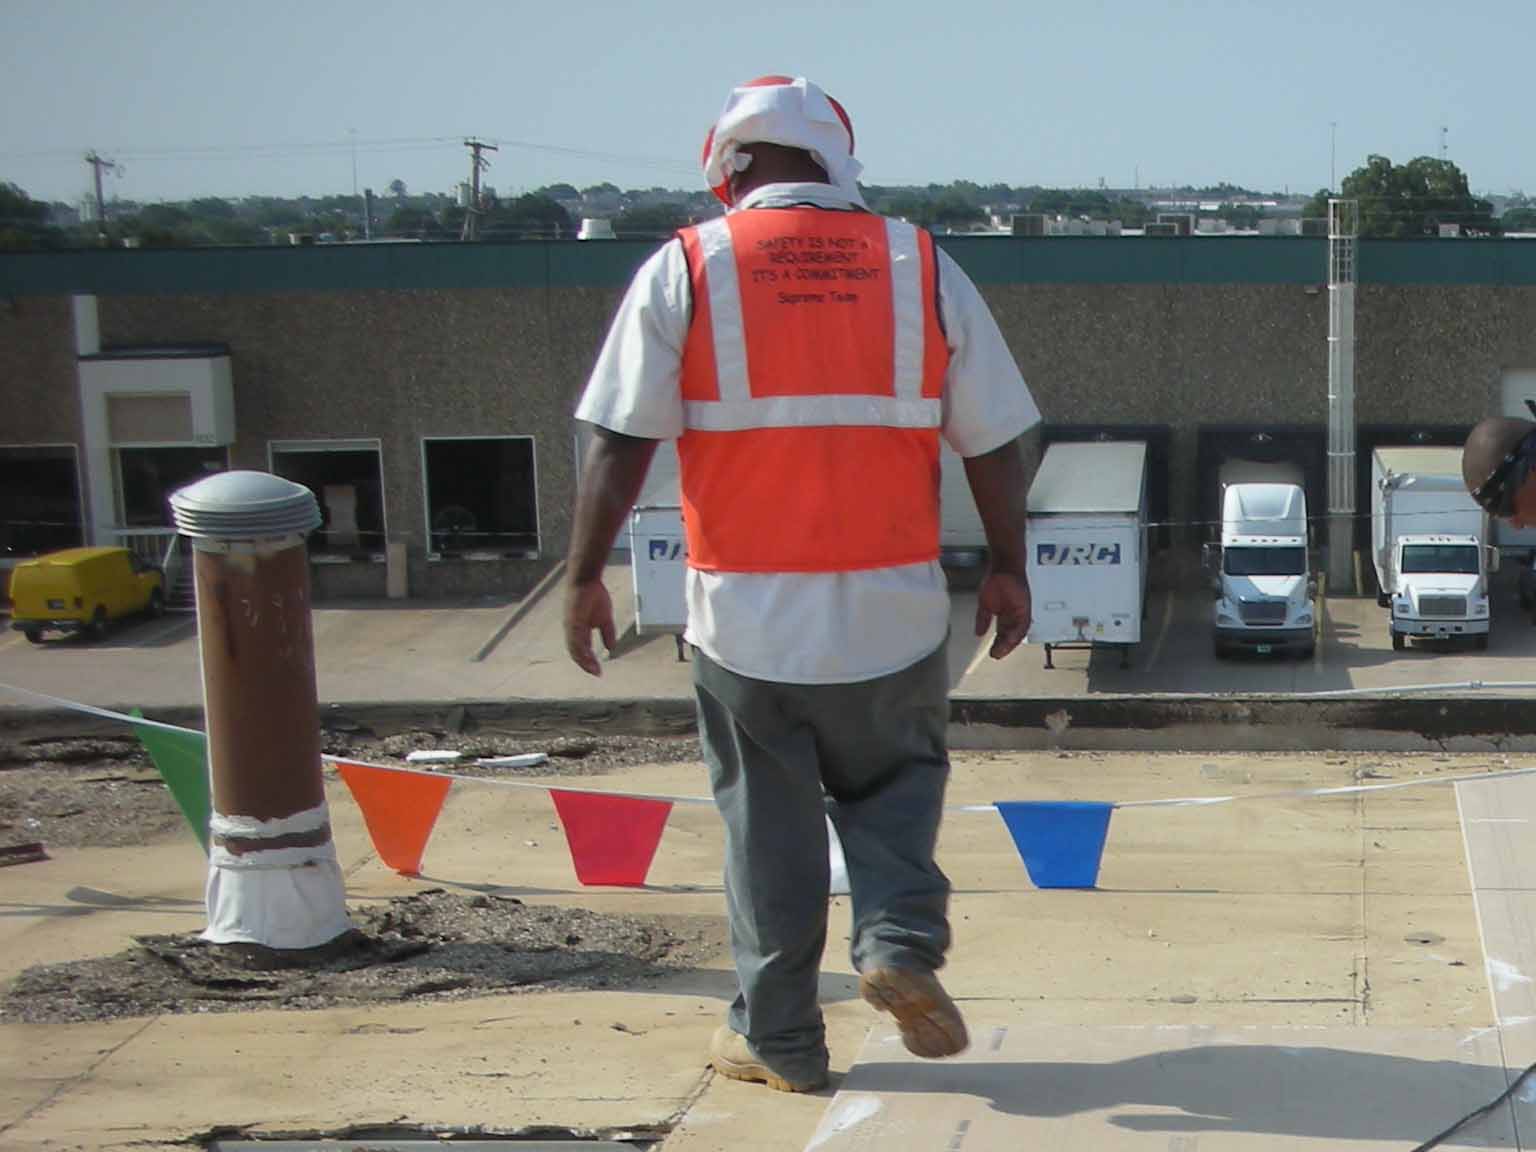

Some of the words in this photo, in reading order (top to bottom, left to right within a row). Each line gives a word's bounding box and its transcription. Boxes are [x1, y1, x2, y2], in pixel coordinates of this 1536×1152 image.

[756, 235, 802, 250] SAFETY
[807, 236, 824, 249] IS
[827, 236, 857, 249] NOT
[860, 236, 872, 249] A
[768, 251, 859, 264] REQUIREMENT
[782, 268, 792, 280] A
[796, 267, 880, 280] COMMITMENT
[777, 291, 824, 304] Supreme
